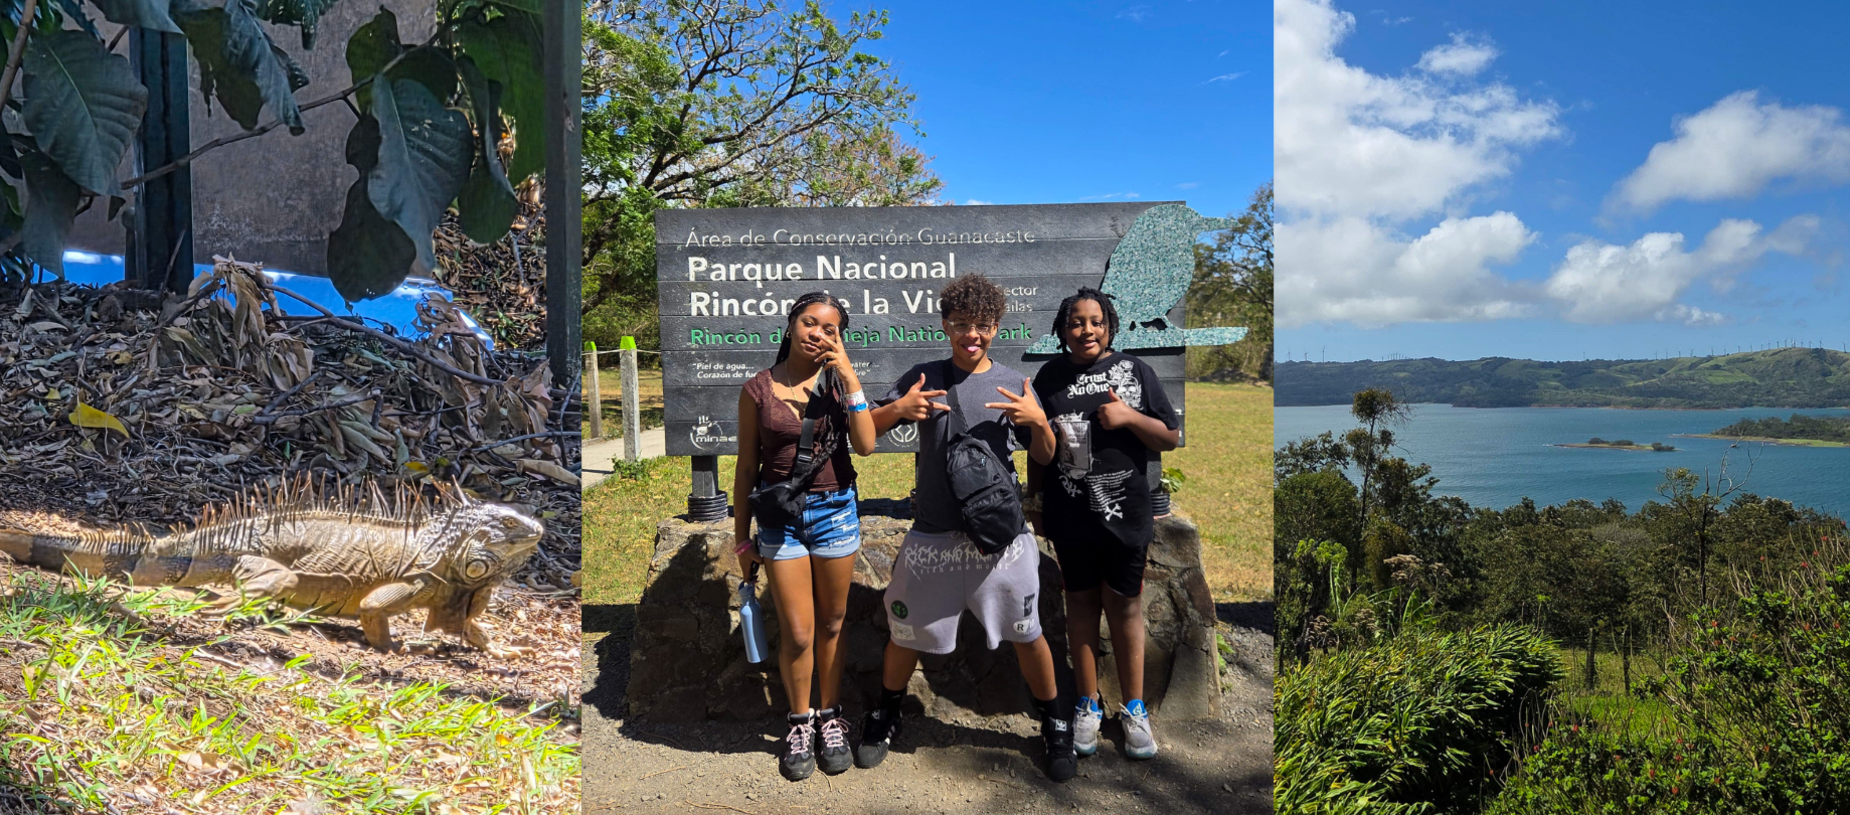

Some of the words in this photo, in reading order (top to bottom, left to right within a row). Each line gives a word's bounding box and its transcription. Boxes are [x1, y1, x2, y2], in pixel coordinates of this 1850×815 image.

[685, 227, 732, 247] Área
[739, 228, 766, 246] de
[773, 228, 911, 247] Conservación
[917, 227, 1036, 246] Guanacaste
[687, 255, 804, 289] Parque
[816, 252, 956, 281] Nacional
[690, 291, 795, 316] Rincón
[863, 289, 889, 315] la
[1003, 300, 1034, 312] ailas
[690, 327, 762, 345] Rincón
[844, 326, 882, 348] ieja
[889, 324, 951, 342] Natio
[999, 322, 1033, 340] ark
[713, 362, 724, 370] de
